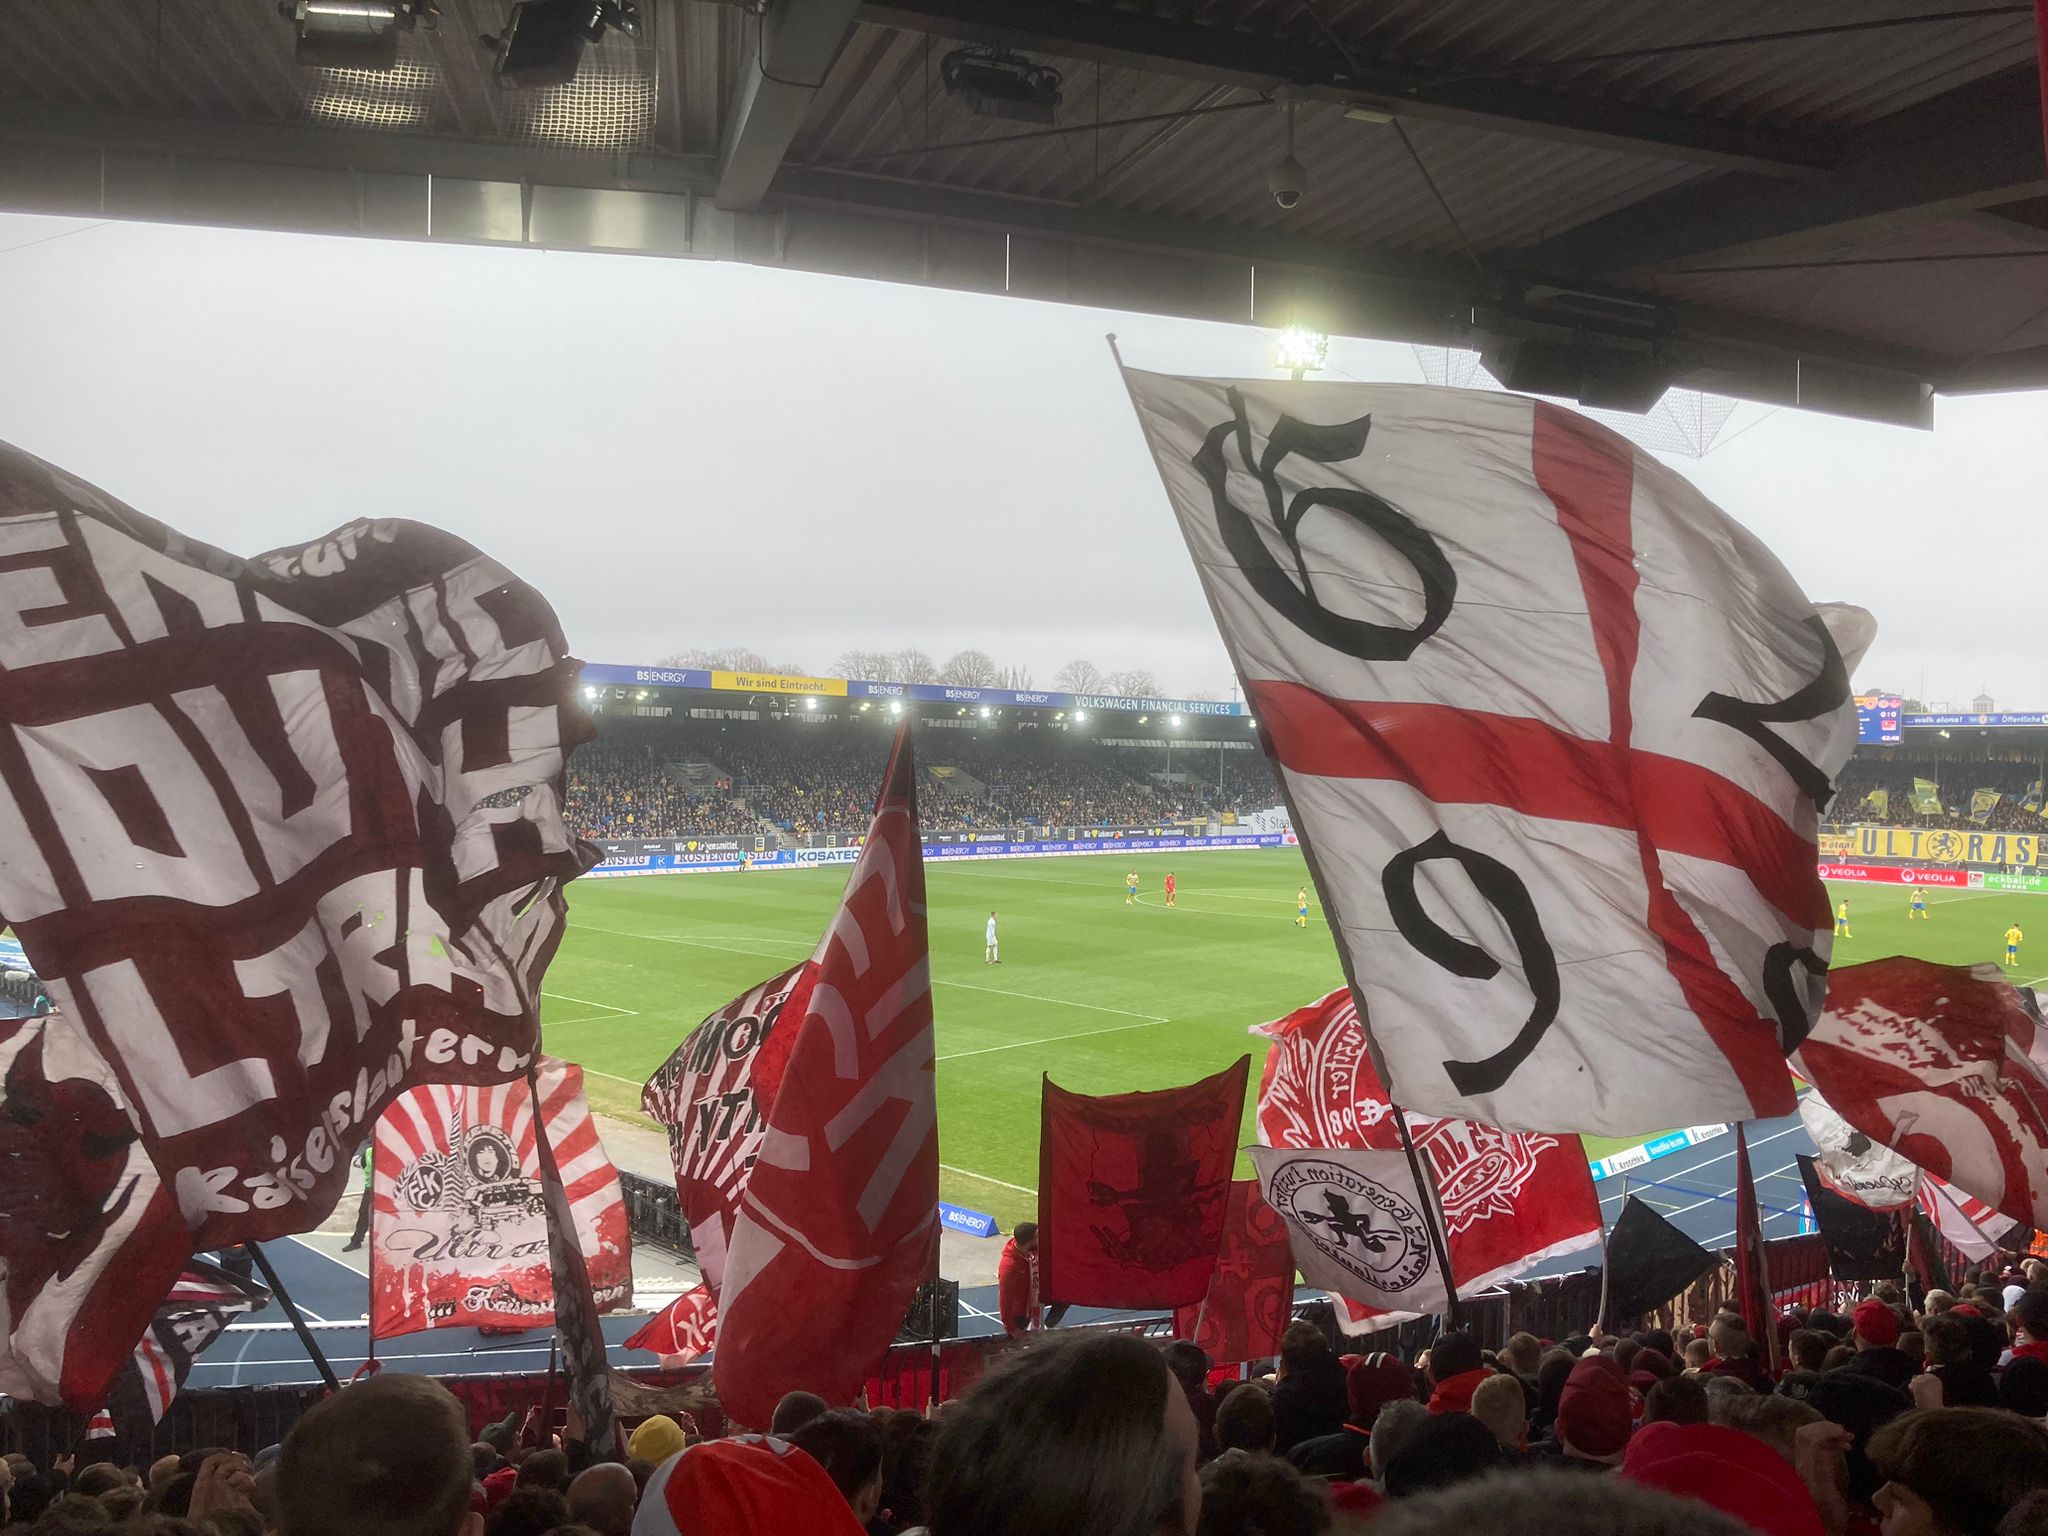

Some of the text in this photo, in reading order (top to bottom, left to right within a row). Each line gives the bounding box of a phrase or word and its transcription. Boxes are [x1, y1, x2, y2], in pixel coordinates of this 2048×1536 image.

[735, 676, 826, 692] Wir sind Eintracht.
[1075, 695, 1230, 715] VOLKSWAGEN FINANCIAL SERVICES
[2001, 715, 2041, 724] Öffentliche
[675, 842, 686, 852] Wir
[1831, 868, 1867, 877] VEOLIA
[1917, 873, 1956, 883] VEOLIA
[1988, 875, 2041, 885] eckball.de
